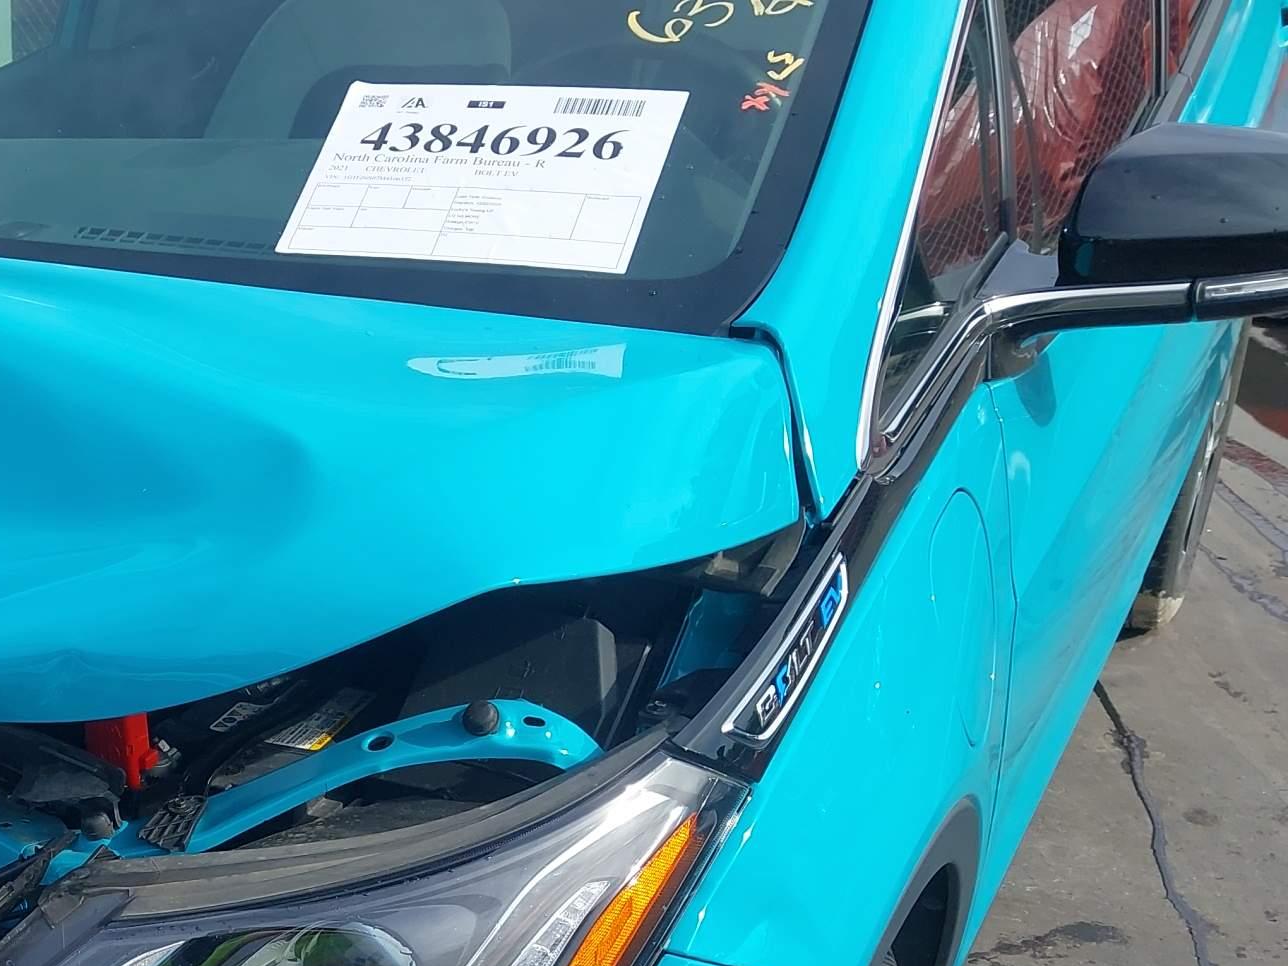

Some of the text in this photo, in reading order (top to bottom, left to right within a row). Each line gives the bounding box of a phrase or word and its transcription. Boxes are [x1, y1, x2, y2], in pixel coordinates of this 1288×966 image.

[360, 122, 631, 160] 43846926
[333, 153, 370, 163] North
[374, 154, 430, 164] Carolina
[434, 155, 468, 165] Farm
[472, 156, 520, 167] Bureau
[534, 159, 546, 168] R
[365, 165, 425, 173] CHEVROLET
[756, 620, 816, 727] BOLT
